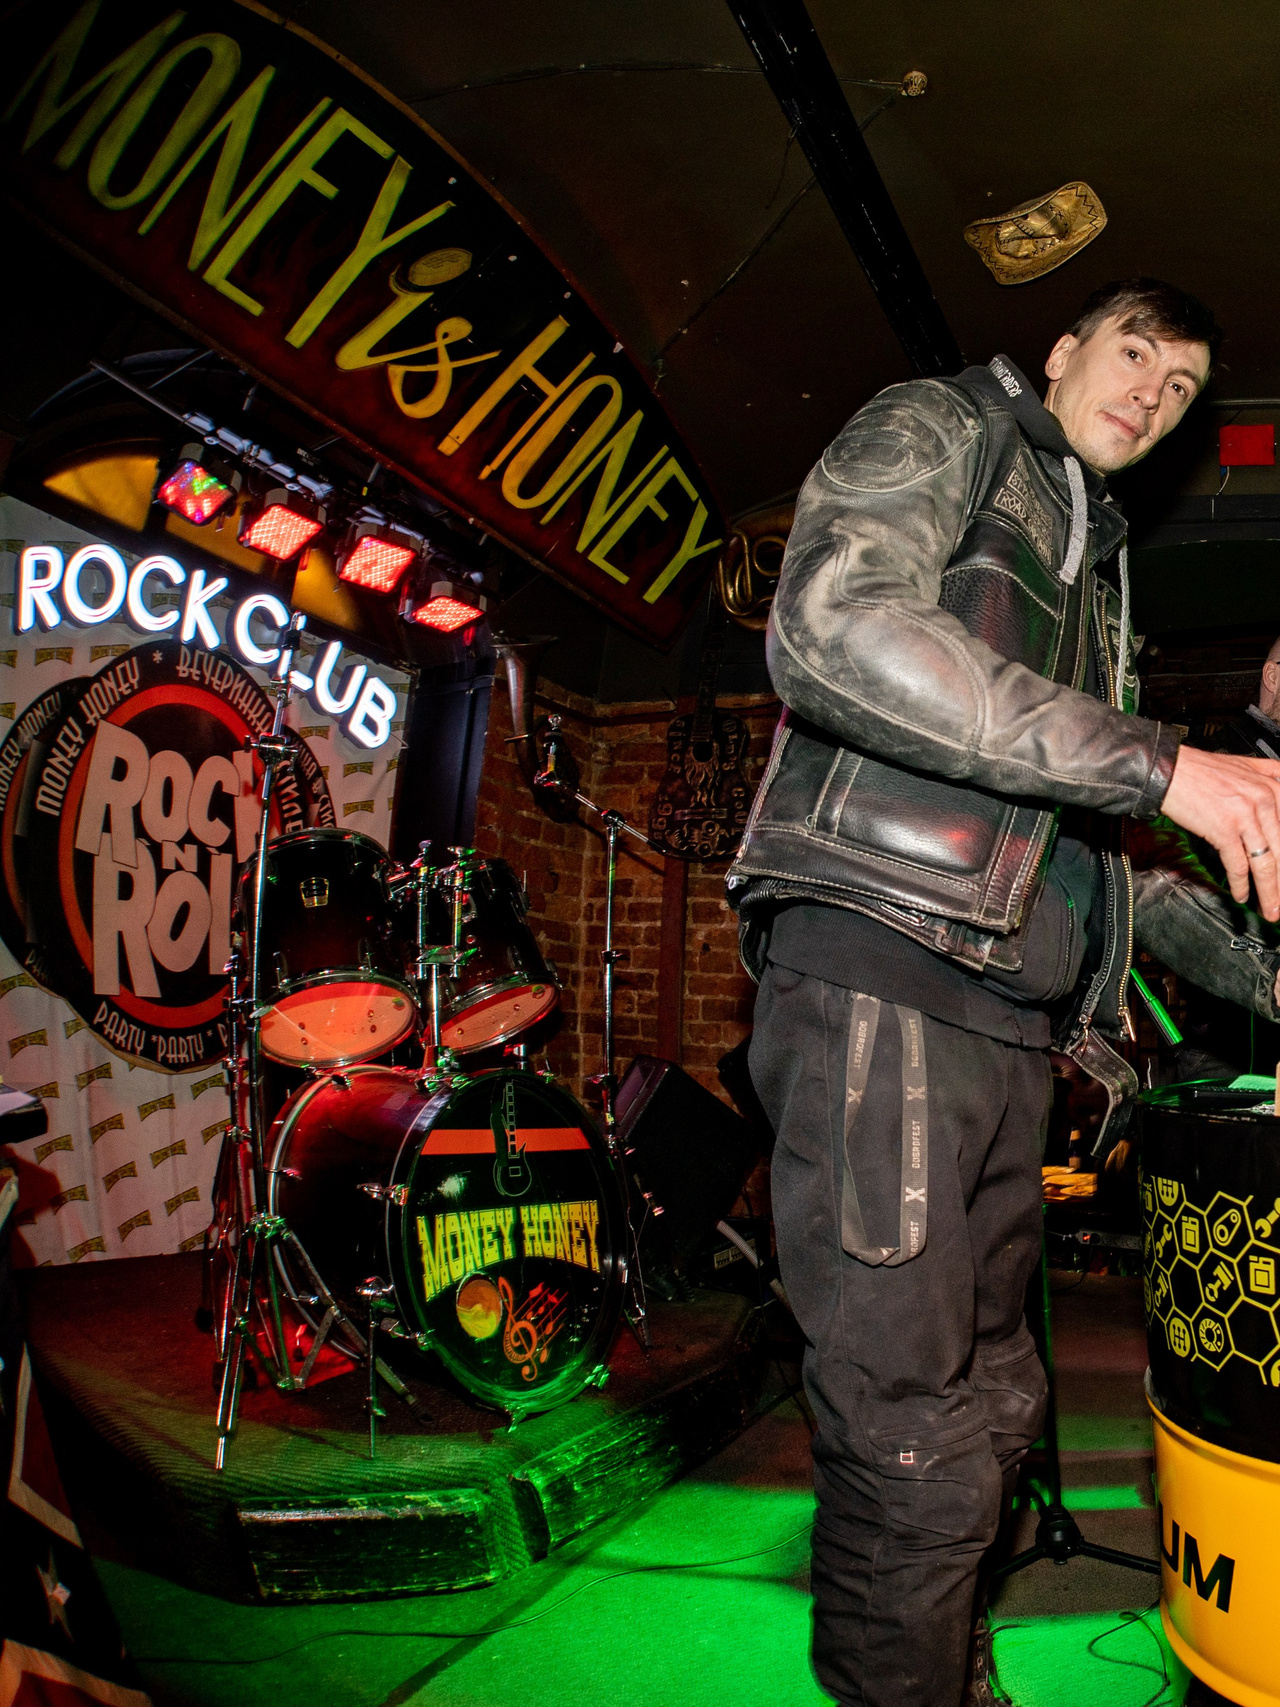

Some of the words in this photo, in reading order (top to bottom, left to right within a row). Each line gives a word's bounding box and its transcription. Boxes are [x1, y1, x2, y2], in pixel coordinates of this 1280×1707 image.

[4, 0, 456, 349] MONEY
[335, 247, 501, 419] is
[437, 314, 723, 604] HONEY
[17, 544, 228, 650] ROCK
[233, 595, 397, 749] CLUB
[35, 715, 84, 817] MONEY
[79, 656, 140, 727] HONEY
[93, 832, 231, 998] ROL
[93, 1000, 146, 1056] PARTY
[155, 1031, 204, 1064] PARTY
[853, 1020, 868, 1069] DOBROFEST
[911, 1120, 921, 1169] DOBROFEST
[416, 1207, 516, 1303] MONEY
[520, 1200, 600, 1274] HONEY
